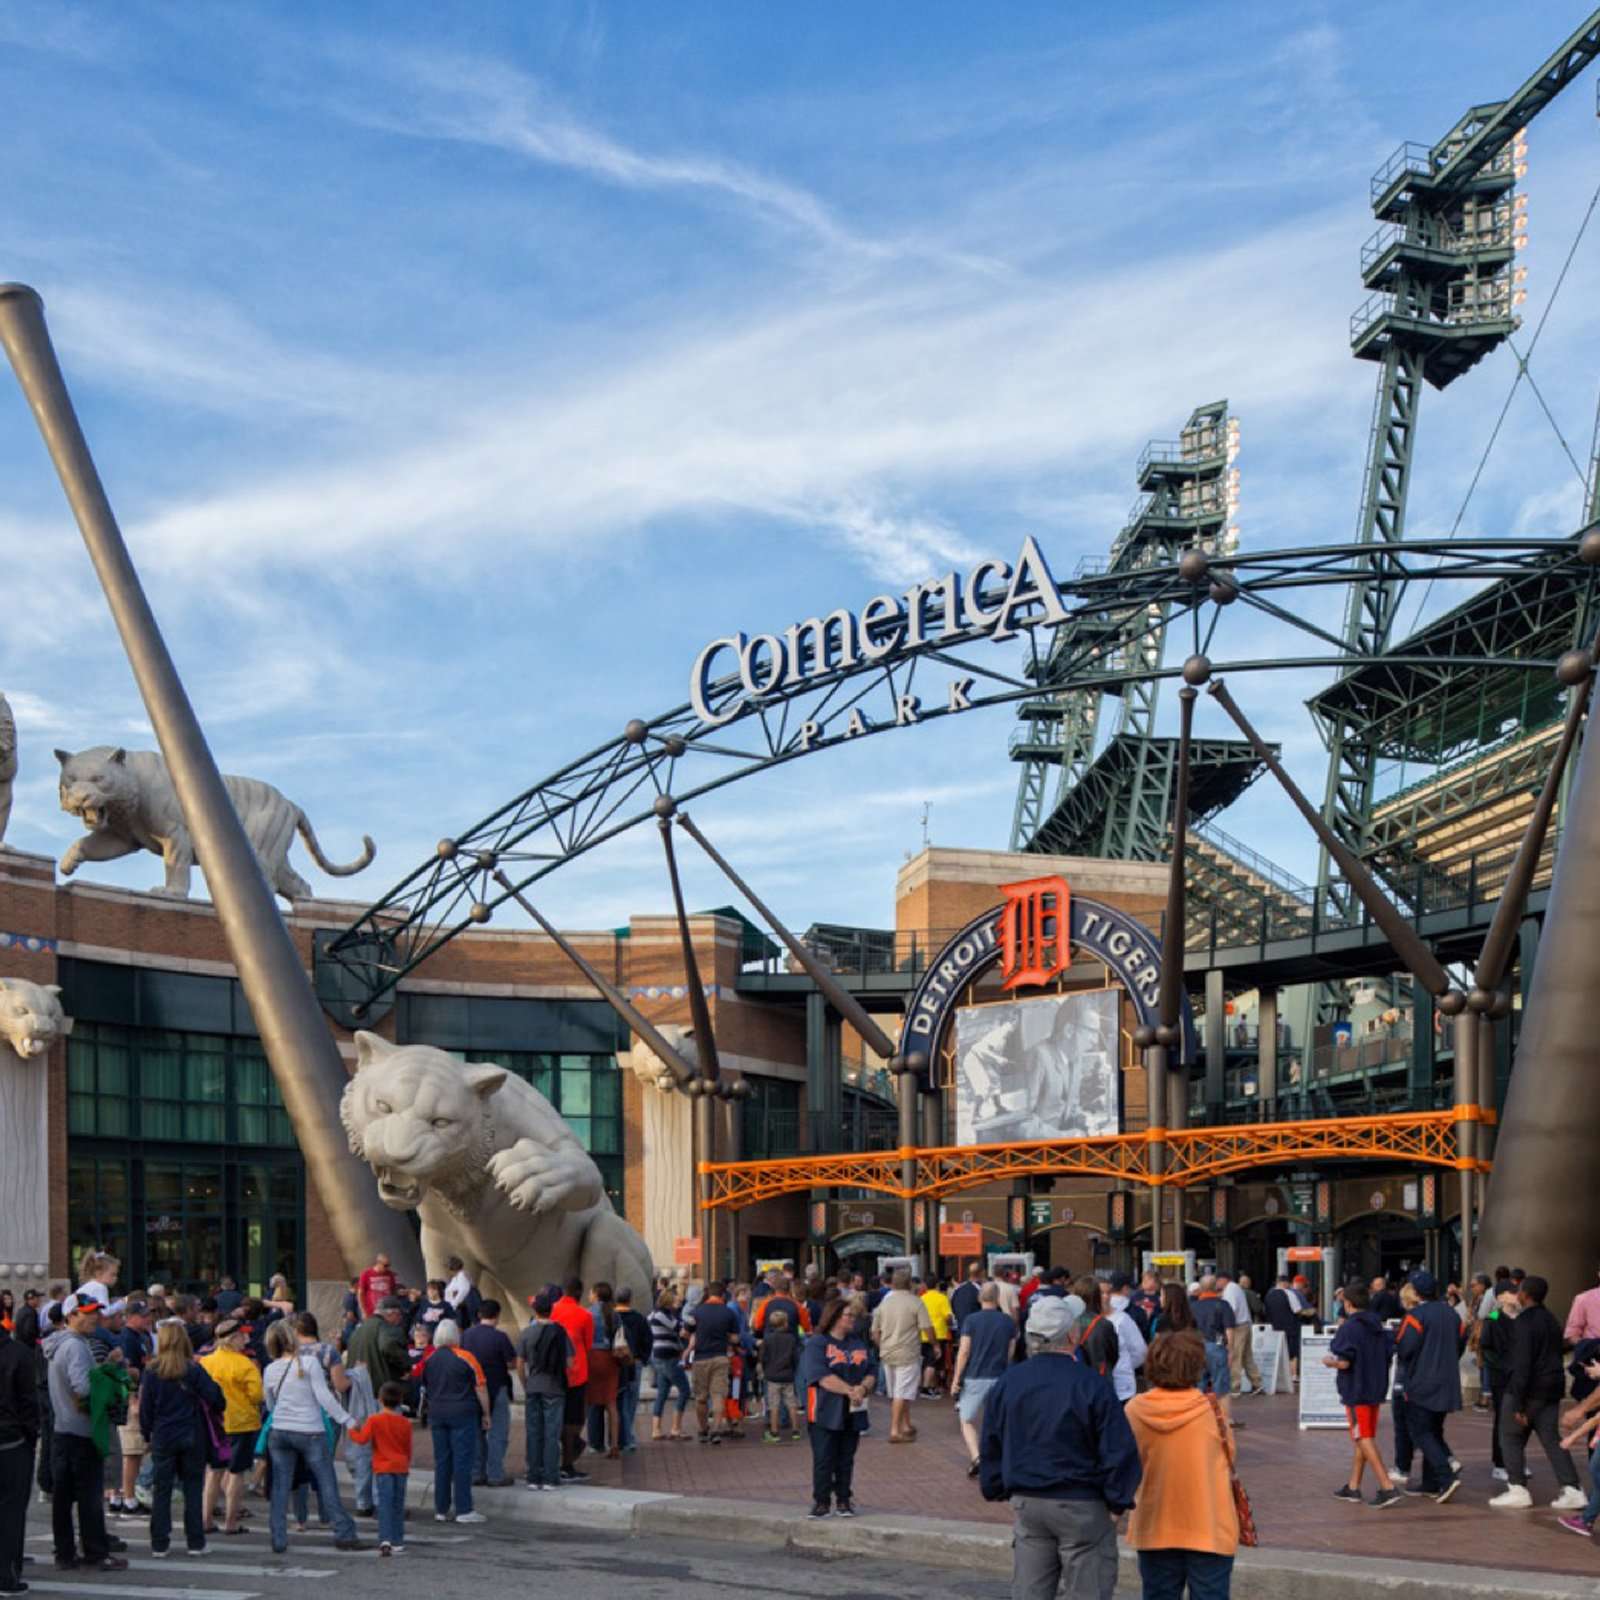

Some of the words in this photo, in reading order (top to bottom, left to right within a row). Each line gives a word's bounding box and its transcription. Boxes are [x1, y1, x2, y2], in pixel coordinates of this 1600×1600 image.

[800, 677, 975, 750] PARK
[911, 921, 997, 1036] DETROIT
[1081, 912, 1161, 1008] TIGERS
[997, 875, 1072, 991] D
